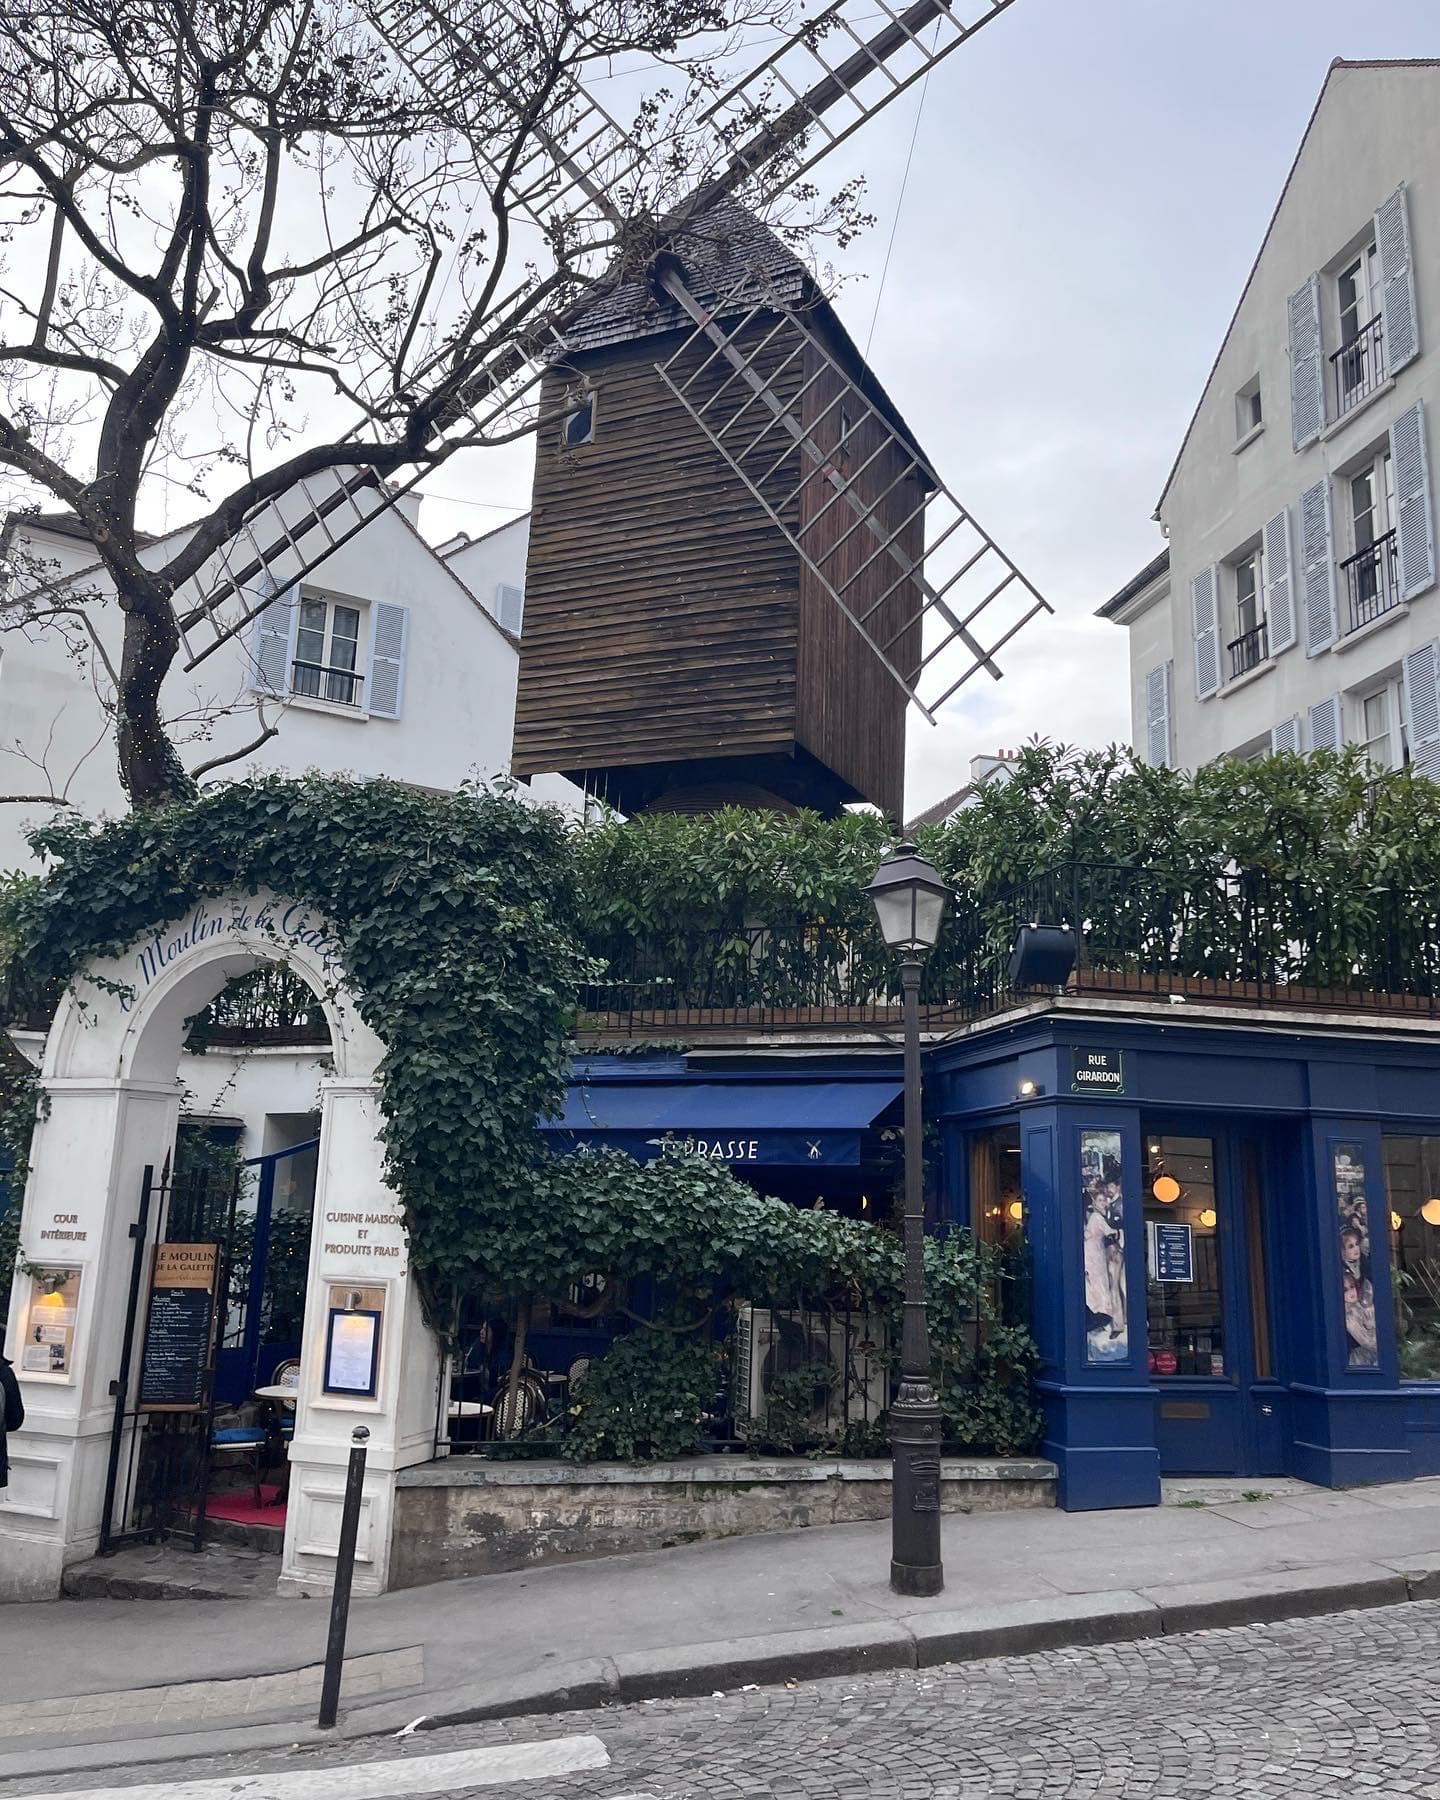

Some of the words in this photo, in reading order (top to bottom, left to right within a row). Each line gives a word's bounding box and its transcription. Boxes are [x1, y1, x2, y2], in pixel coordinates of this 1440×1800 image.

[136, 904, 225, 985] Moulin
[1088, 1055, 1107, 1066] RUE
[1076, 1070, 1120, 1083] GIRARDON
[53, 1214, 78, 1224] COUR
[326, 1212, 363, 1224] CUISINE
[365, 1213, 401, 1225] MAISON
[40, 1229, 87, 1241] INTÉRIEURE
[357, 1229, 368, 1239] ET
[324, 1244, 372, 1256] PRODUITS
[373, 1246, 399, 1257] FRAIS
[169, 1252, 215, 1262] MOULIN
[167, 1263, 177, 1271] LA
